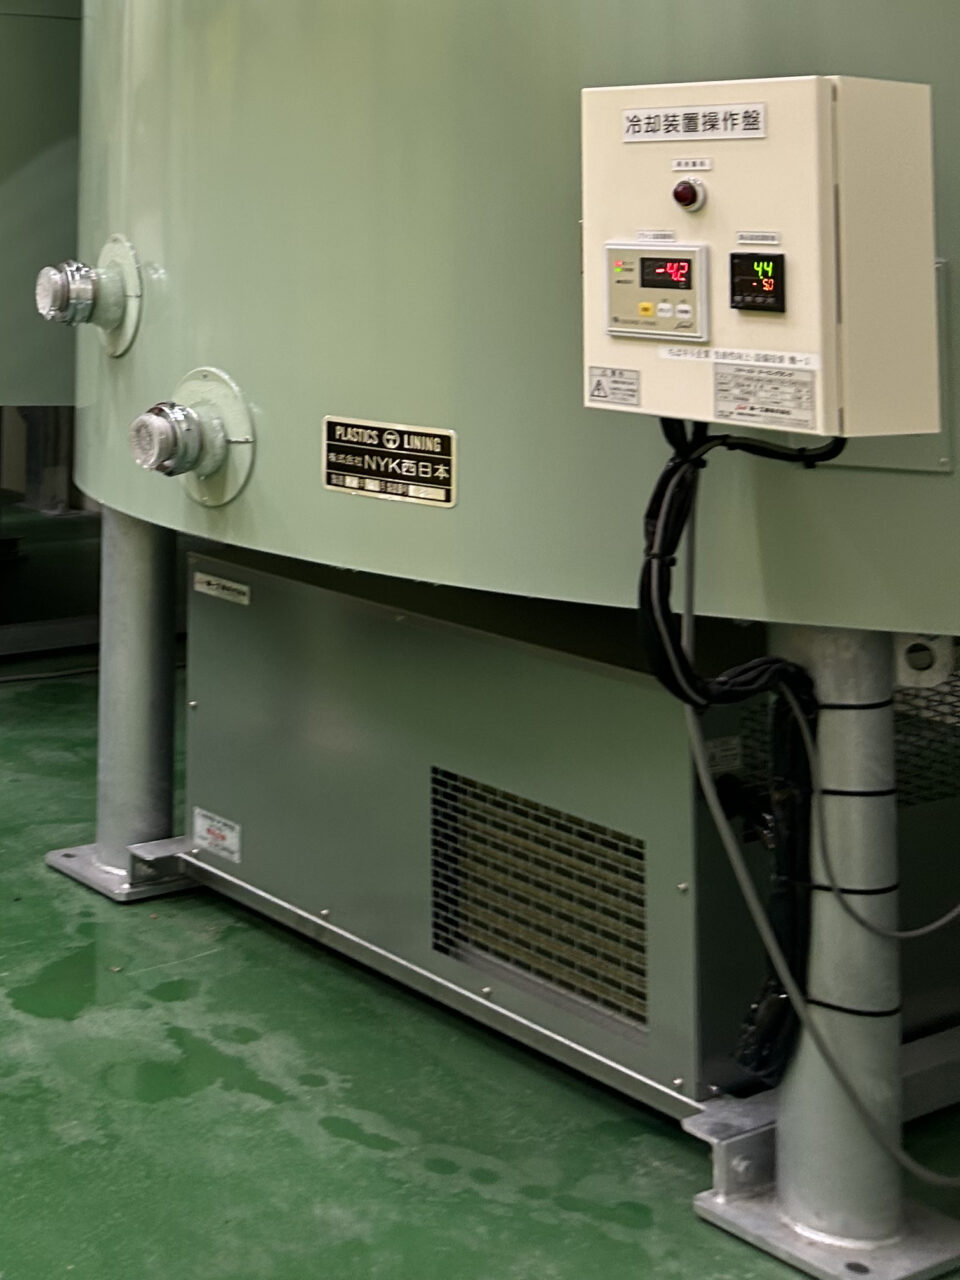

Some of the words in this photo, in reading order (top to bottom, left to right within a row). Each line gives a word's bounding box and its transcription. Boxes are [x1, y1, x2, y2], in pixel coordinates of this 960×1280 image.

[625, 110, 761, 134] 冷却装置操作盤
[335, 425, 379, 445] PLASTICS
[403, 434, 441, 452] LINING
